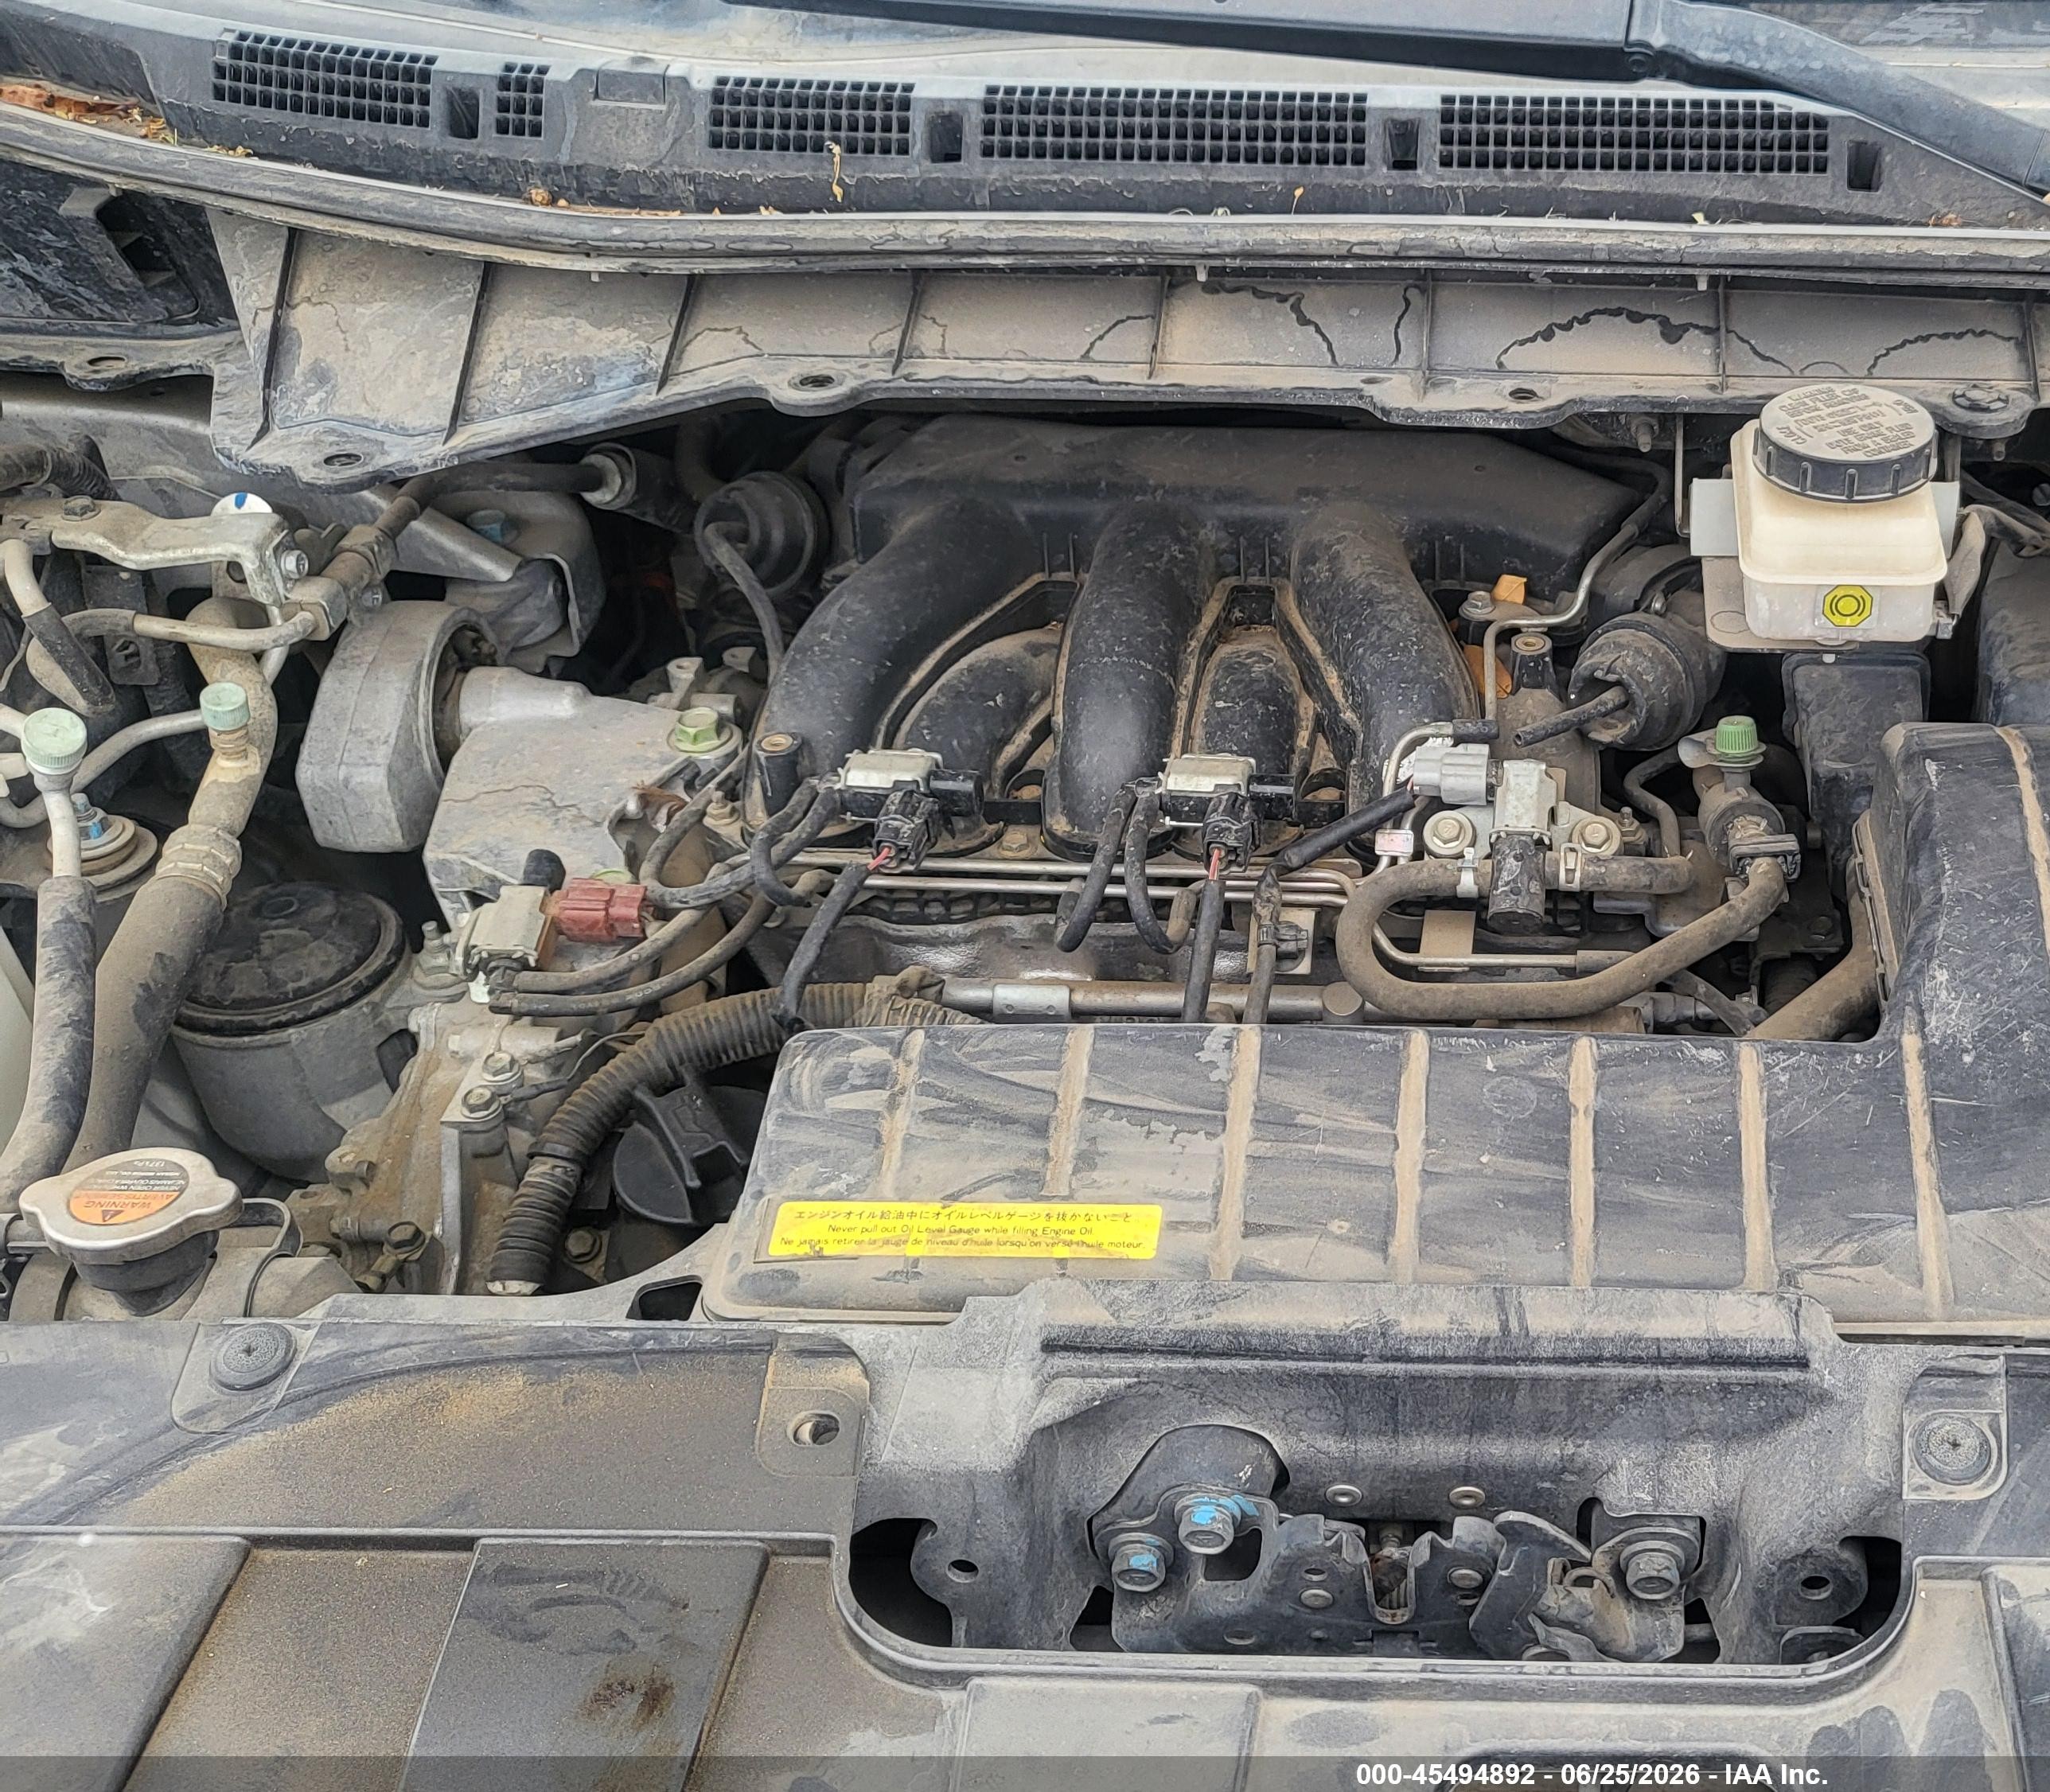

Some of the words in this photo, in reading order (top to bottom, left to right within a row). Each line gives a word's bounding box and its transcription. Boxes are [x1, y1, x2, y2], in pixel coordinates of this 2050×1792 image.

[1837, 427, 1859, 437] USE
[83, 1200, 151, 1209] WARNING
[828, 1225, 859, 1233] Never
[860, 1224, 879, 1235] pull
[901, 1224, 914, 1234] Oil
[917, 1225, 946, 1233] Level
[949, 1225, 980, 1236] Gauge
[1013, 1225, 1039, 1237] filling
[1042, 1226, 1076, 1238] Engine
[780, 1237, 794, 1245] Ne
[797, 1237, 829, 1247] jamais
[878, 1238, 909, 1248] jauge
[996, 1238, 1042, 1249] lorsqu'on
